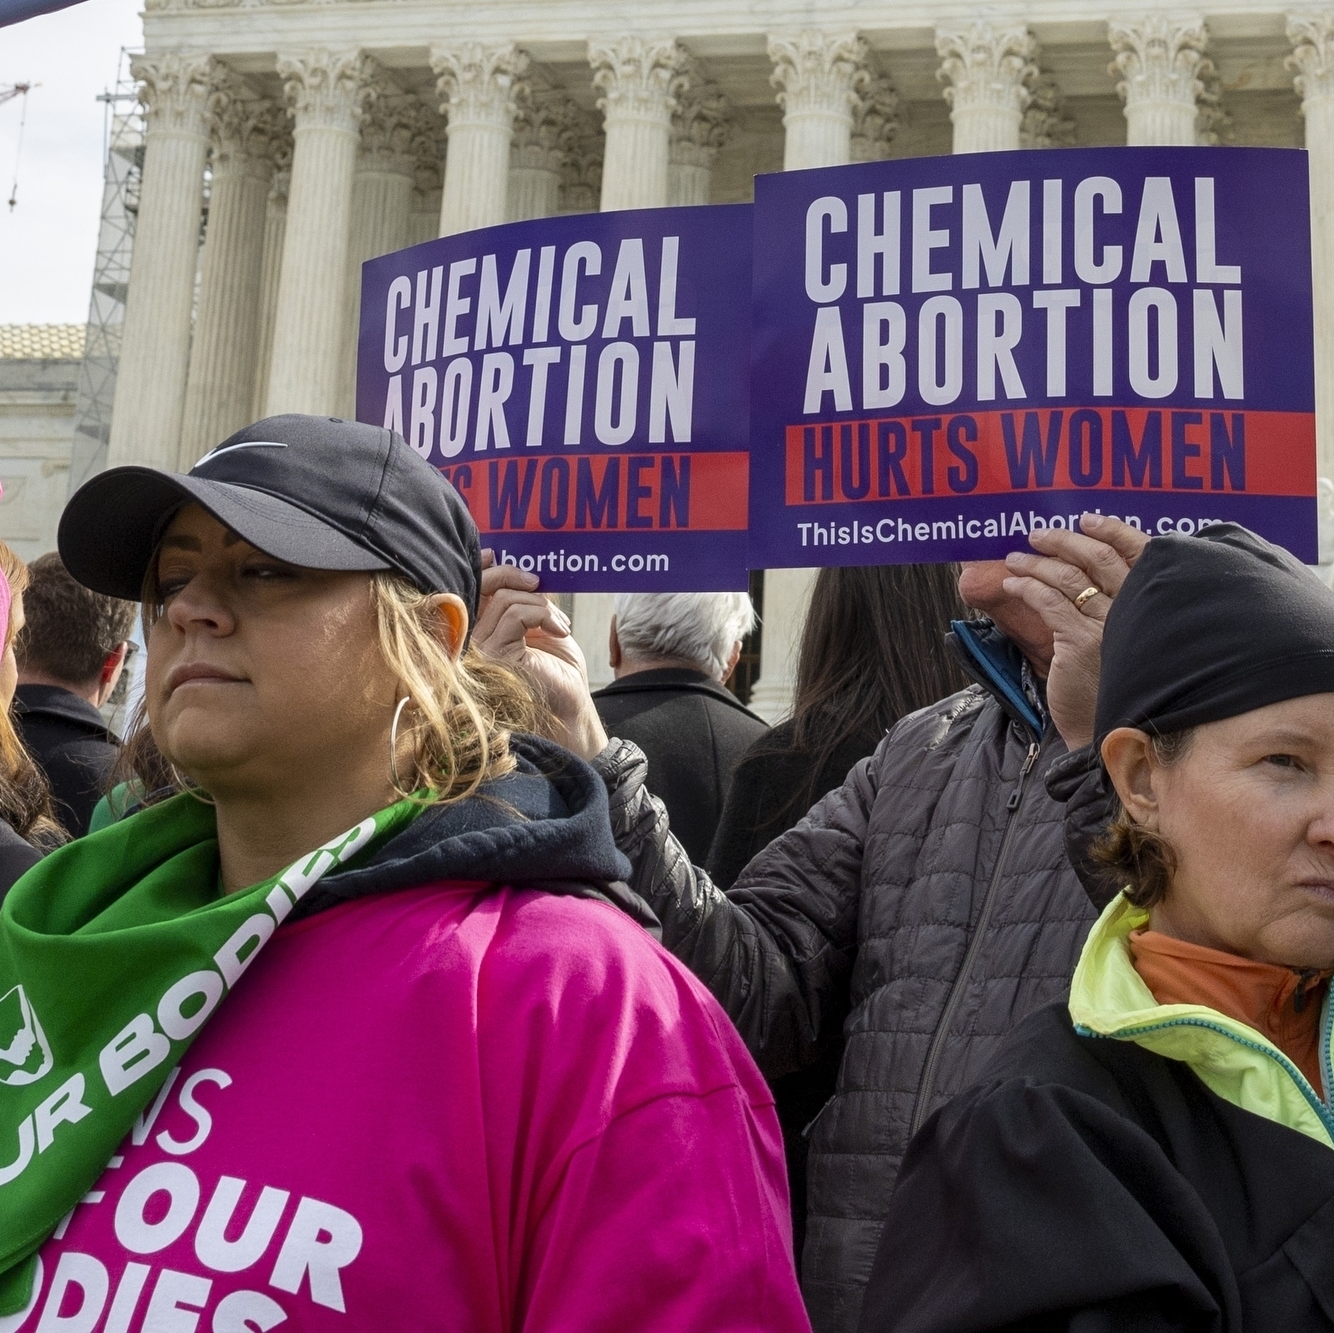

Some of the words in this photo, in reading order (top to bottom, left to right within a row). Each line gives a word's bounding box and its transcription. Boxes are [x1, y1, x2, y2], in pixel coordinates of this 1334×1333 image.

[804, 176, 1241, 304] CHEMICAL
[383, 236, 697, 373] CHEMICAL
[802, 286, 1244, 414] ABORTION
[383, 340, 696, 461] ABORTION
[802, 413, 979, 503] HURTS
[1000, 408, 1246, 493] WOMEN
[488, 455, 692, 530] WOMEN
[114, 1161, 364, 1313] OUR
